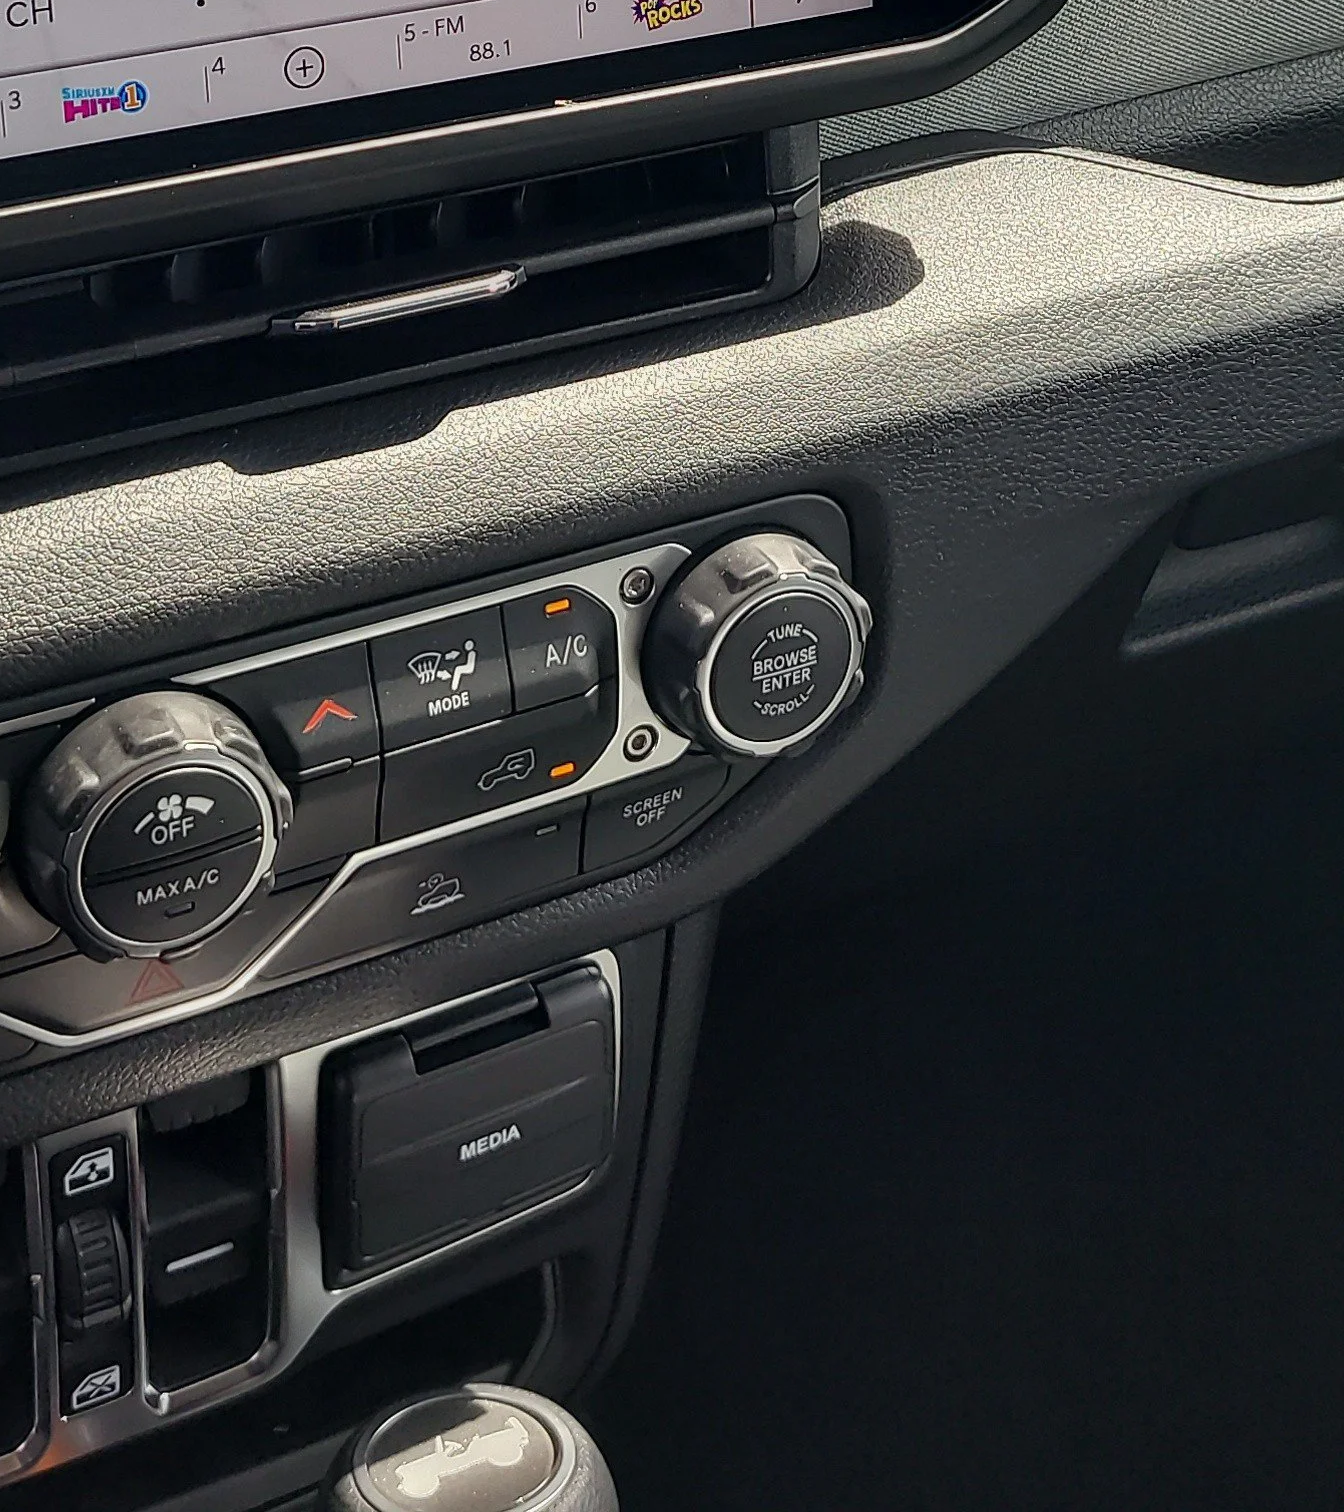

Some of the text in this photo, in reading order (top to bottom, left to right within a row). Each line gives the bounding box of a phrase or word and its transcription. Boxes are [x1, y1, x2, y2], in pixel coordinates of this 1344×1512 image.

[404, 23, 416, 42] 5
[434, 16, 465, 38] FM
[469, 40, 511, 62] 88.1
[212, 57, 226, 76] 4
[8, 91, 22, 110] 3
[125, 83, 142, 109] 1
[767, 623, 802, 644] TUNE
[545, 633, 588, 668] A/C
[752, 645, 817, 676] BROWSE
[761, 667, 812, 694] ENTER
[428, 691, 470, 717] MODE
[760, 692, 810, 717] SCROLL
[623, 788, 683, 819] SCREEN
[151, 816, 196, 845] OFF
[636, 807, 666, 828] OFF
[136, 867, 220, 907] MAX A/C
[459, 1123, 521, 1161] MEDIA
